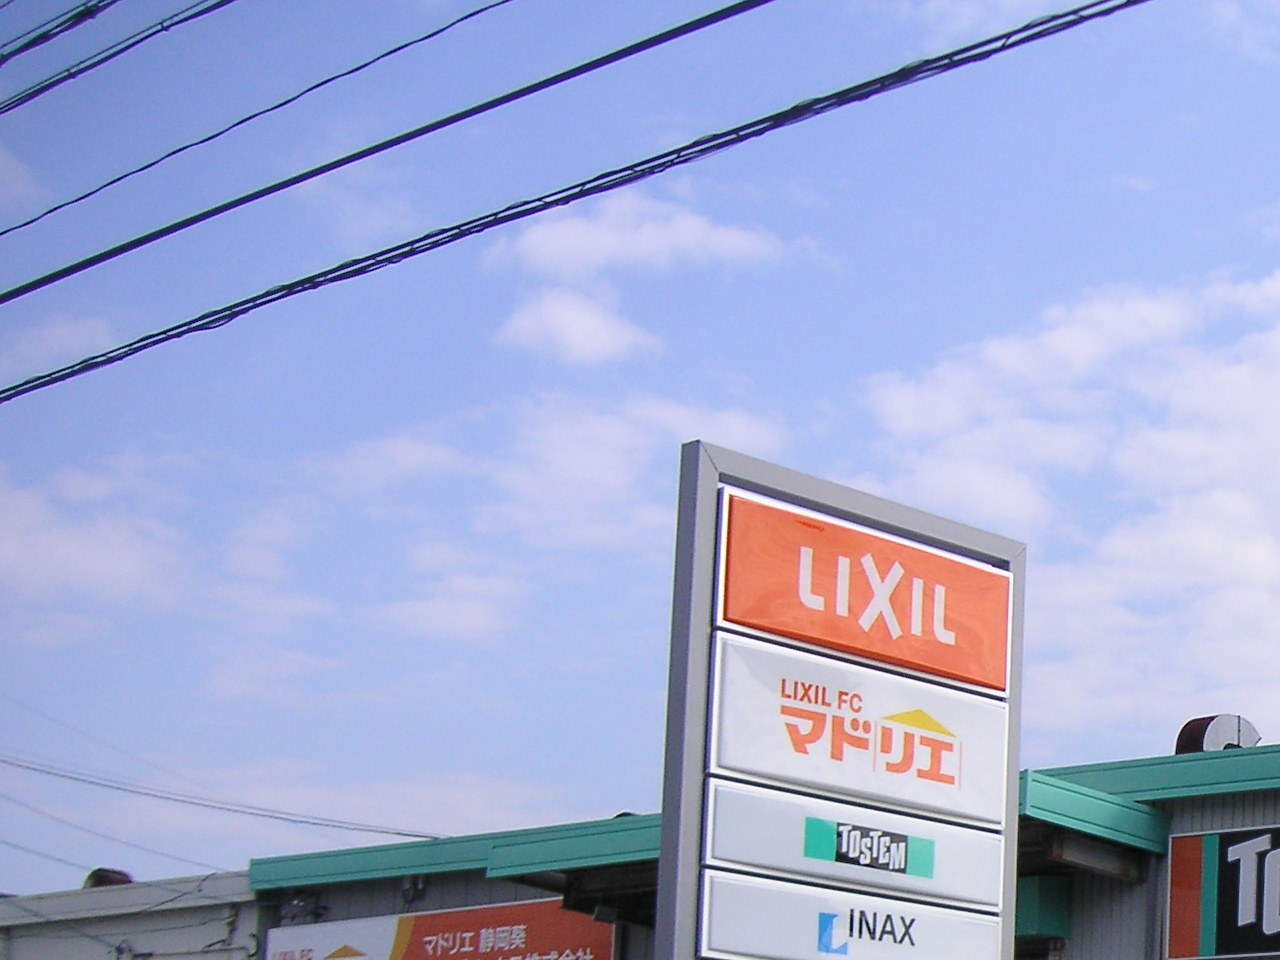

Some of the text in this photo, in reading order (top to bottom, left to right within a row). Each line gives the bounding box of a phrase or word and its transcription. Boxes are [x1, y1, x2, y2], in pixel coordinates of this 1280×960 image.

[797, 546, 956, 646] LIXIL
[780, 678, 863, 713] LIXIL FC
[780, 704, 956, 786] マドリエ
[838, 823, 906, 871] TOSTEM
[422, 925, 527, 957] マドリエ 静岡葵
[848, 908, 917, 946] INAX
